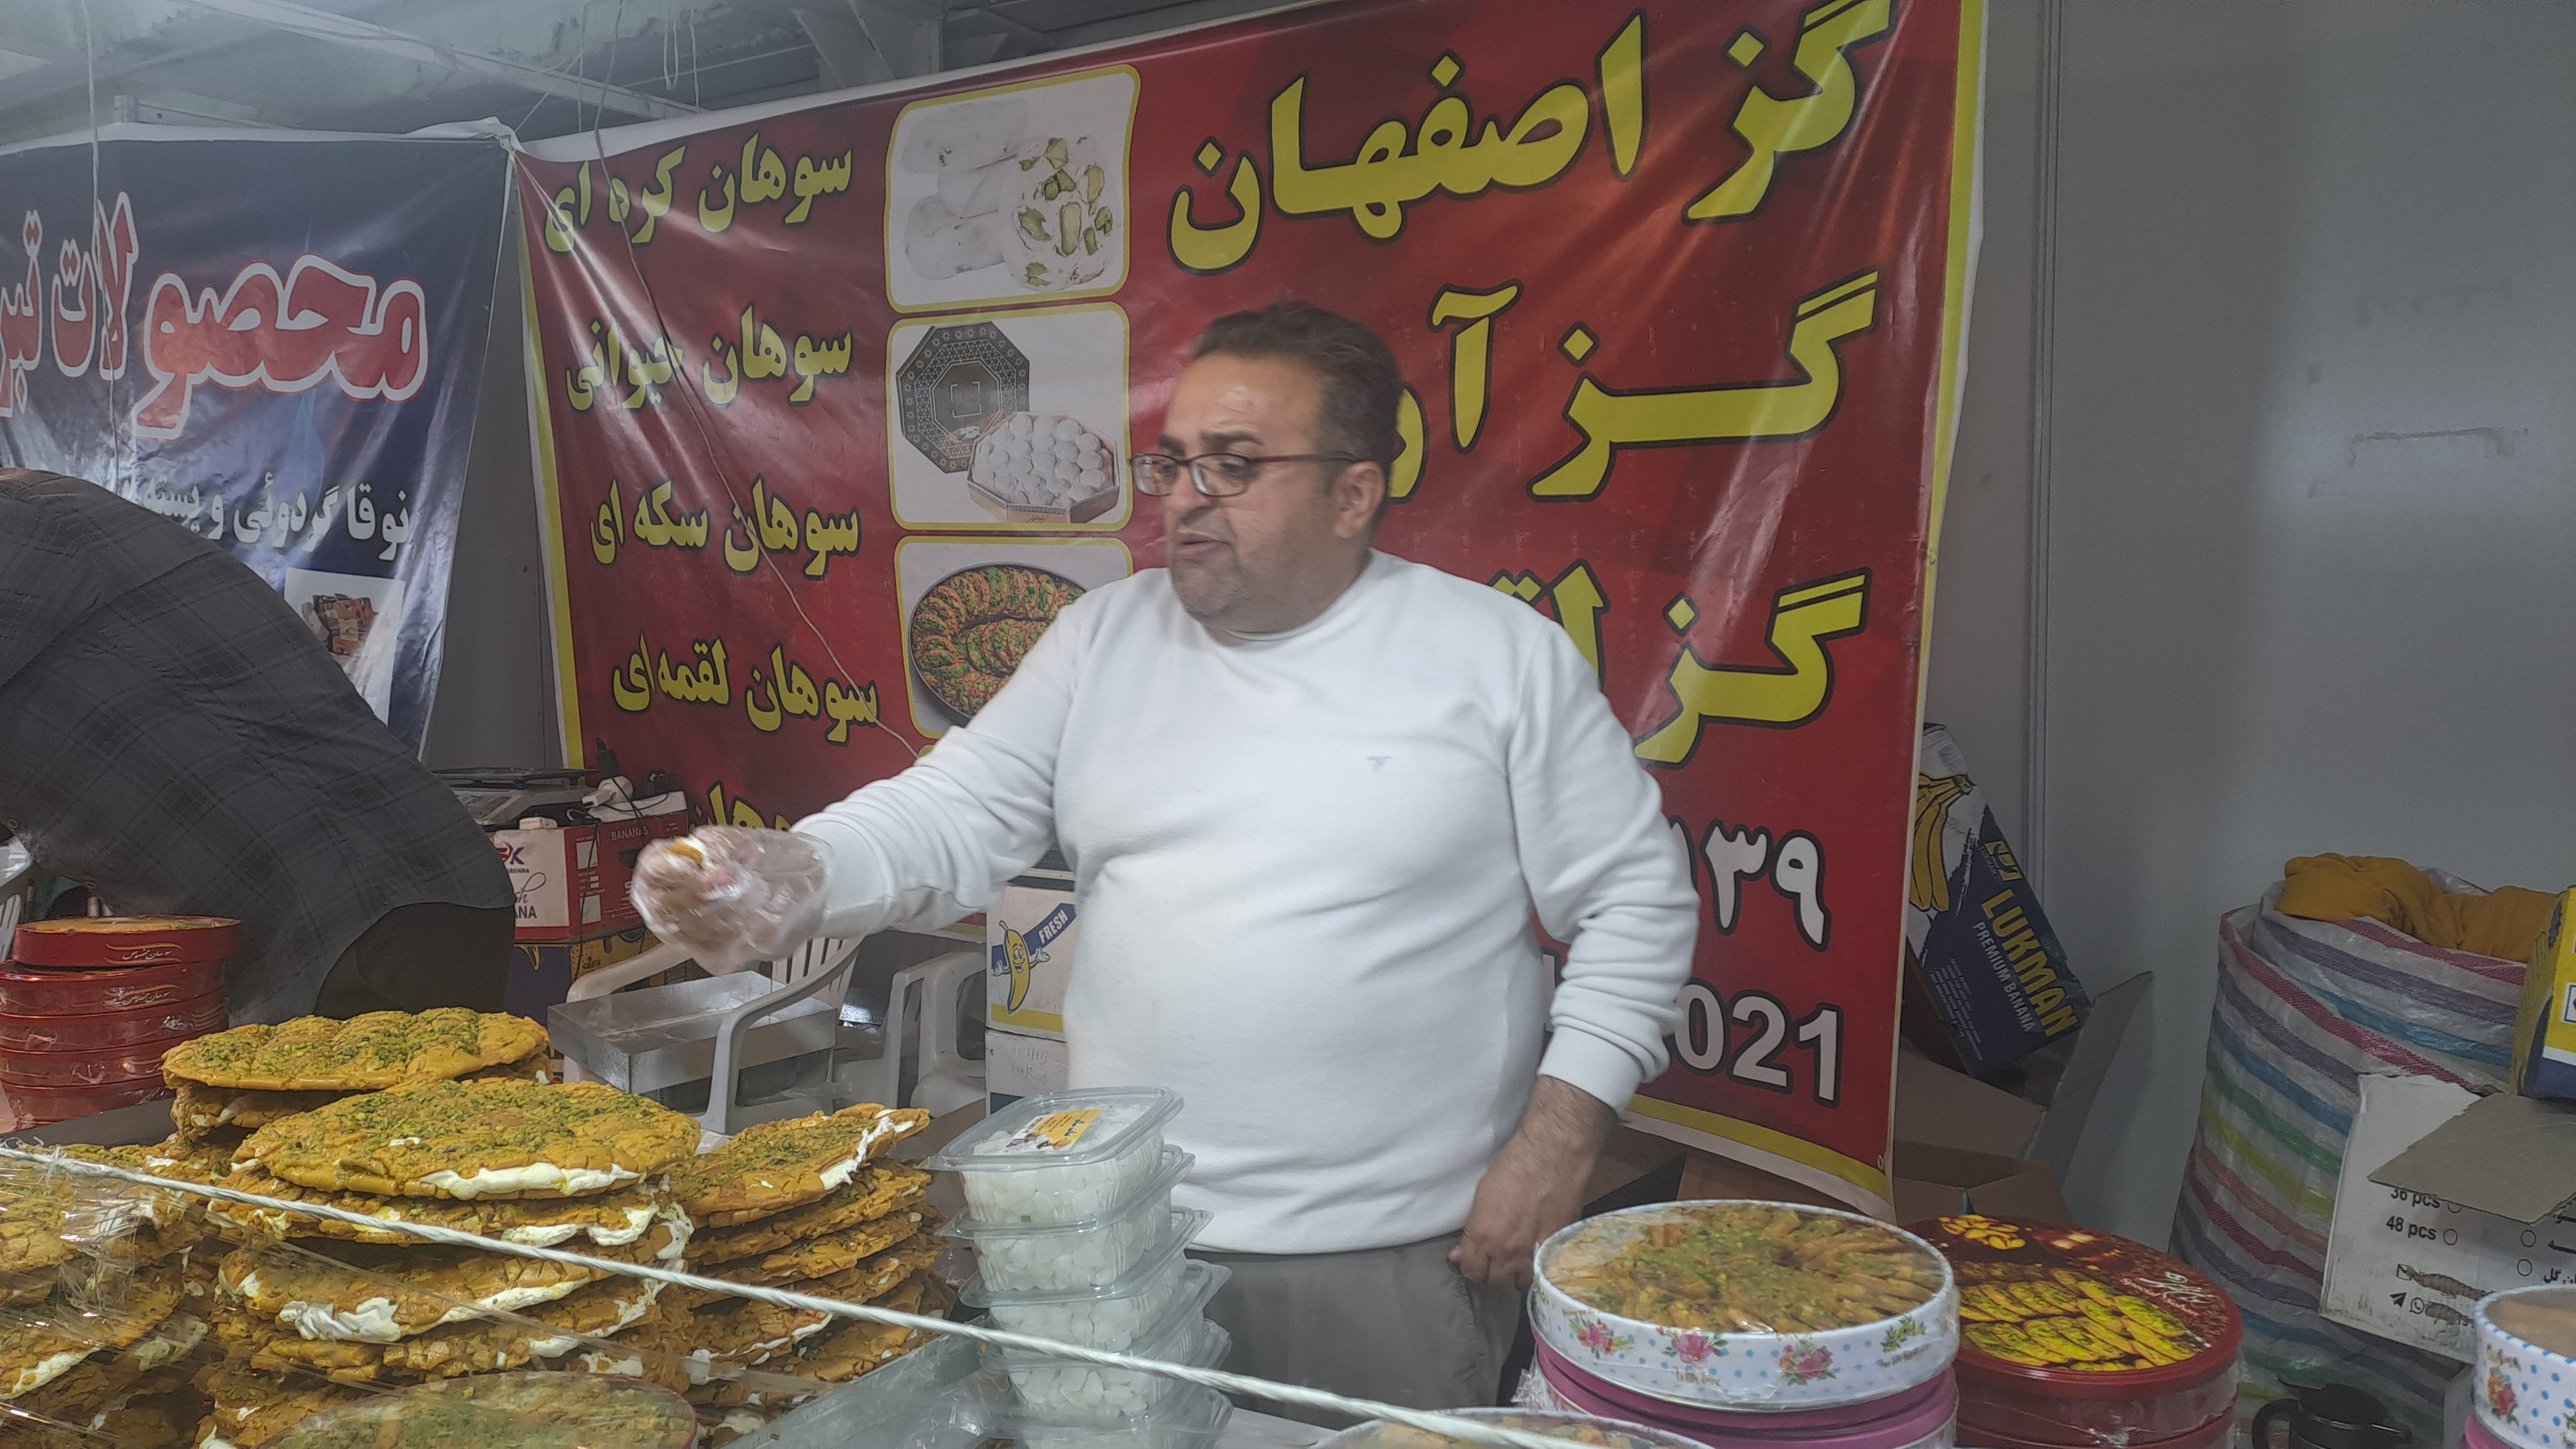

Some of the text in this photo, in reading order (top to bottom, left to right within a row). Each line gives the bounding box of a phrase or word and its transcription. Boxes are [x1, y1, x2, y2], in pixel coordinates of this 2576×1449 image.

[697, 131, 853, 233] سوهان
[1169, 0, 1893, 274] گز اصفهان
[608, 144, 687, 244] کره
[703, 305, 853, 405] سوهان
[1529, 268, 1881, 503] گز
[207, 494, 224, 540] و
[589, 478, 860, 576] سوهان سکه ای
[745, 645, 878, 744] سوهان
[1634, 568, 1870, 767] گز
[1037, 909, 1069, 945] FRESH
[1973, 922, 2037, 1032] PREMIUM BANANA
[1982, 888, 2080, 1037] LUKMAN
[2385, 1215, 2437, 1240] 48 pcs
